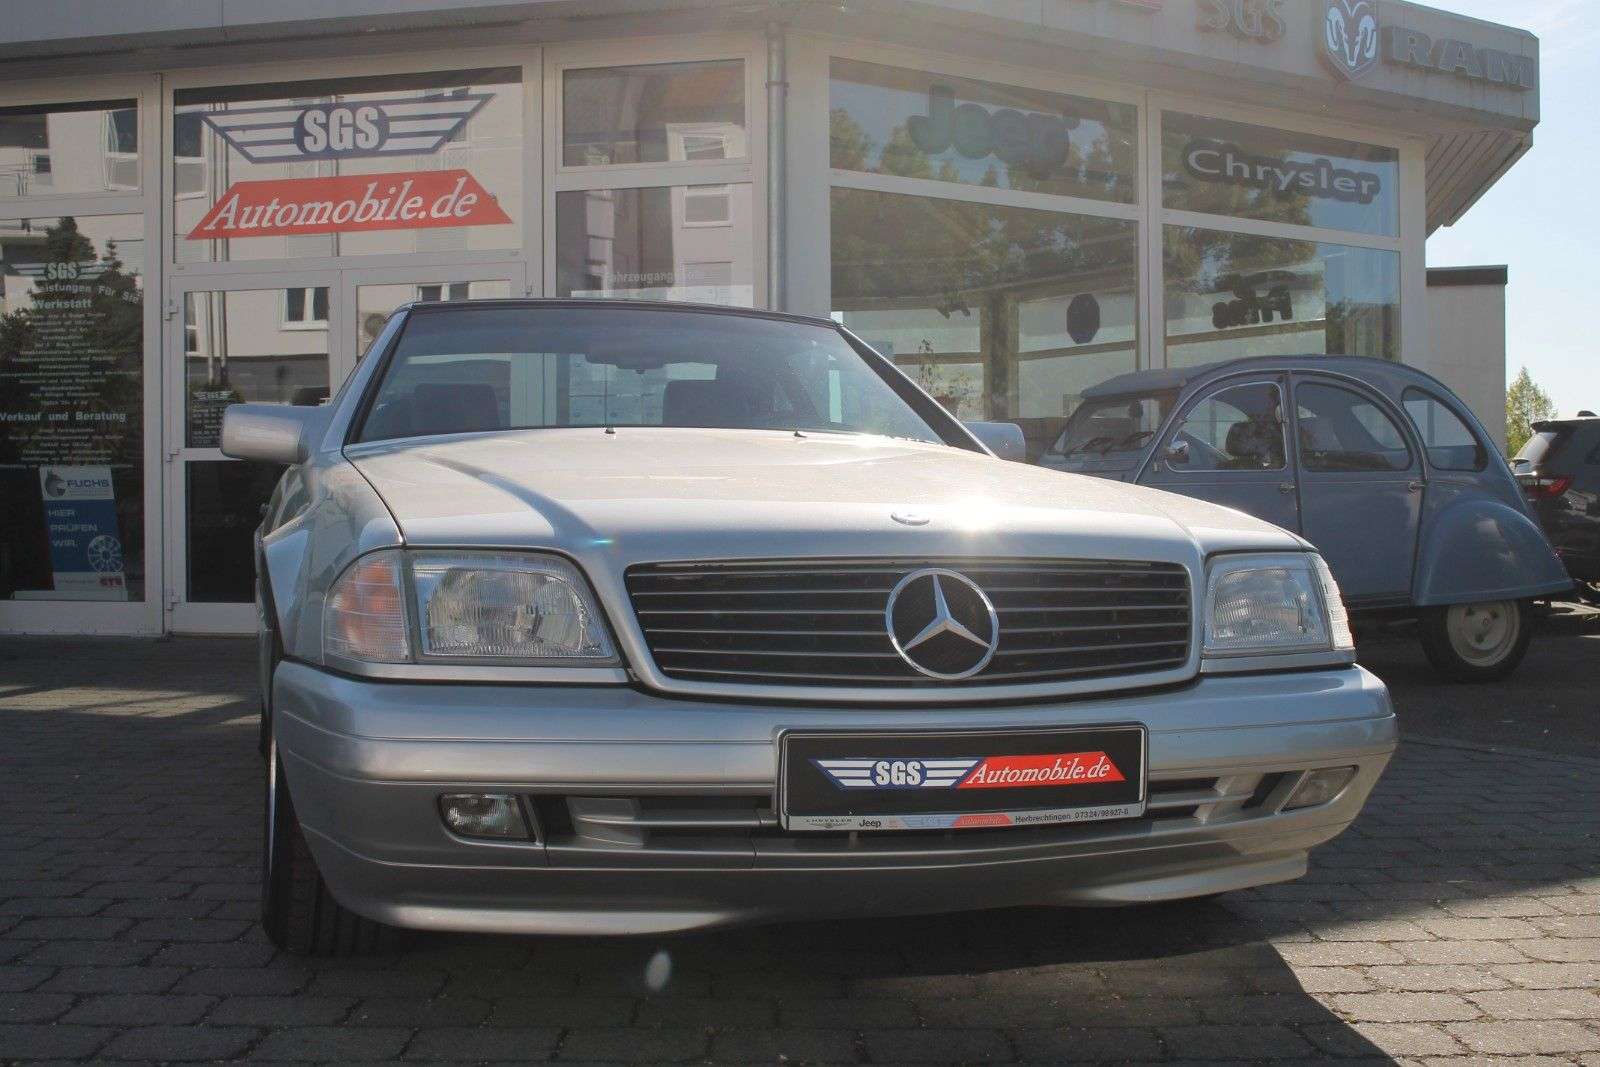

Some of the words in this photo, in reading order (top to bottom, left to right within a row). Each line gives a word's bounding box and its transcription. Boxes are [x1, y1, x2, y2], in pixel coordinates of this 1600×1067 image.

[1383, 27, 1537, 90] RAM
[303, 105, 381, 153] SGS
[1186, 149, 1377, 196] Chrysler
[203, 176, 478, 231] Automobile.de
[47, 262, 78, 280] SGS
[0, 411, 41, 422] Verkauf
[48, 411, 69, 421] und
[75, 411, 126, 423] Beratung
[66, 479, 110, 489] FUCHS
[874, 760, 923, 786] SGS
[966, 755, 1111, 785] Automobile.de
[858, 818, 882, 829] Jeep
